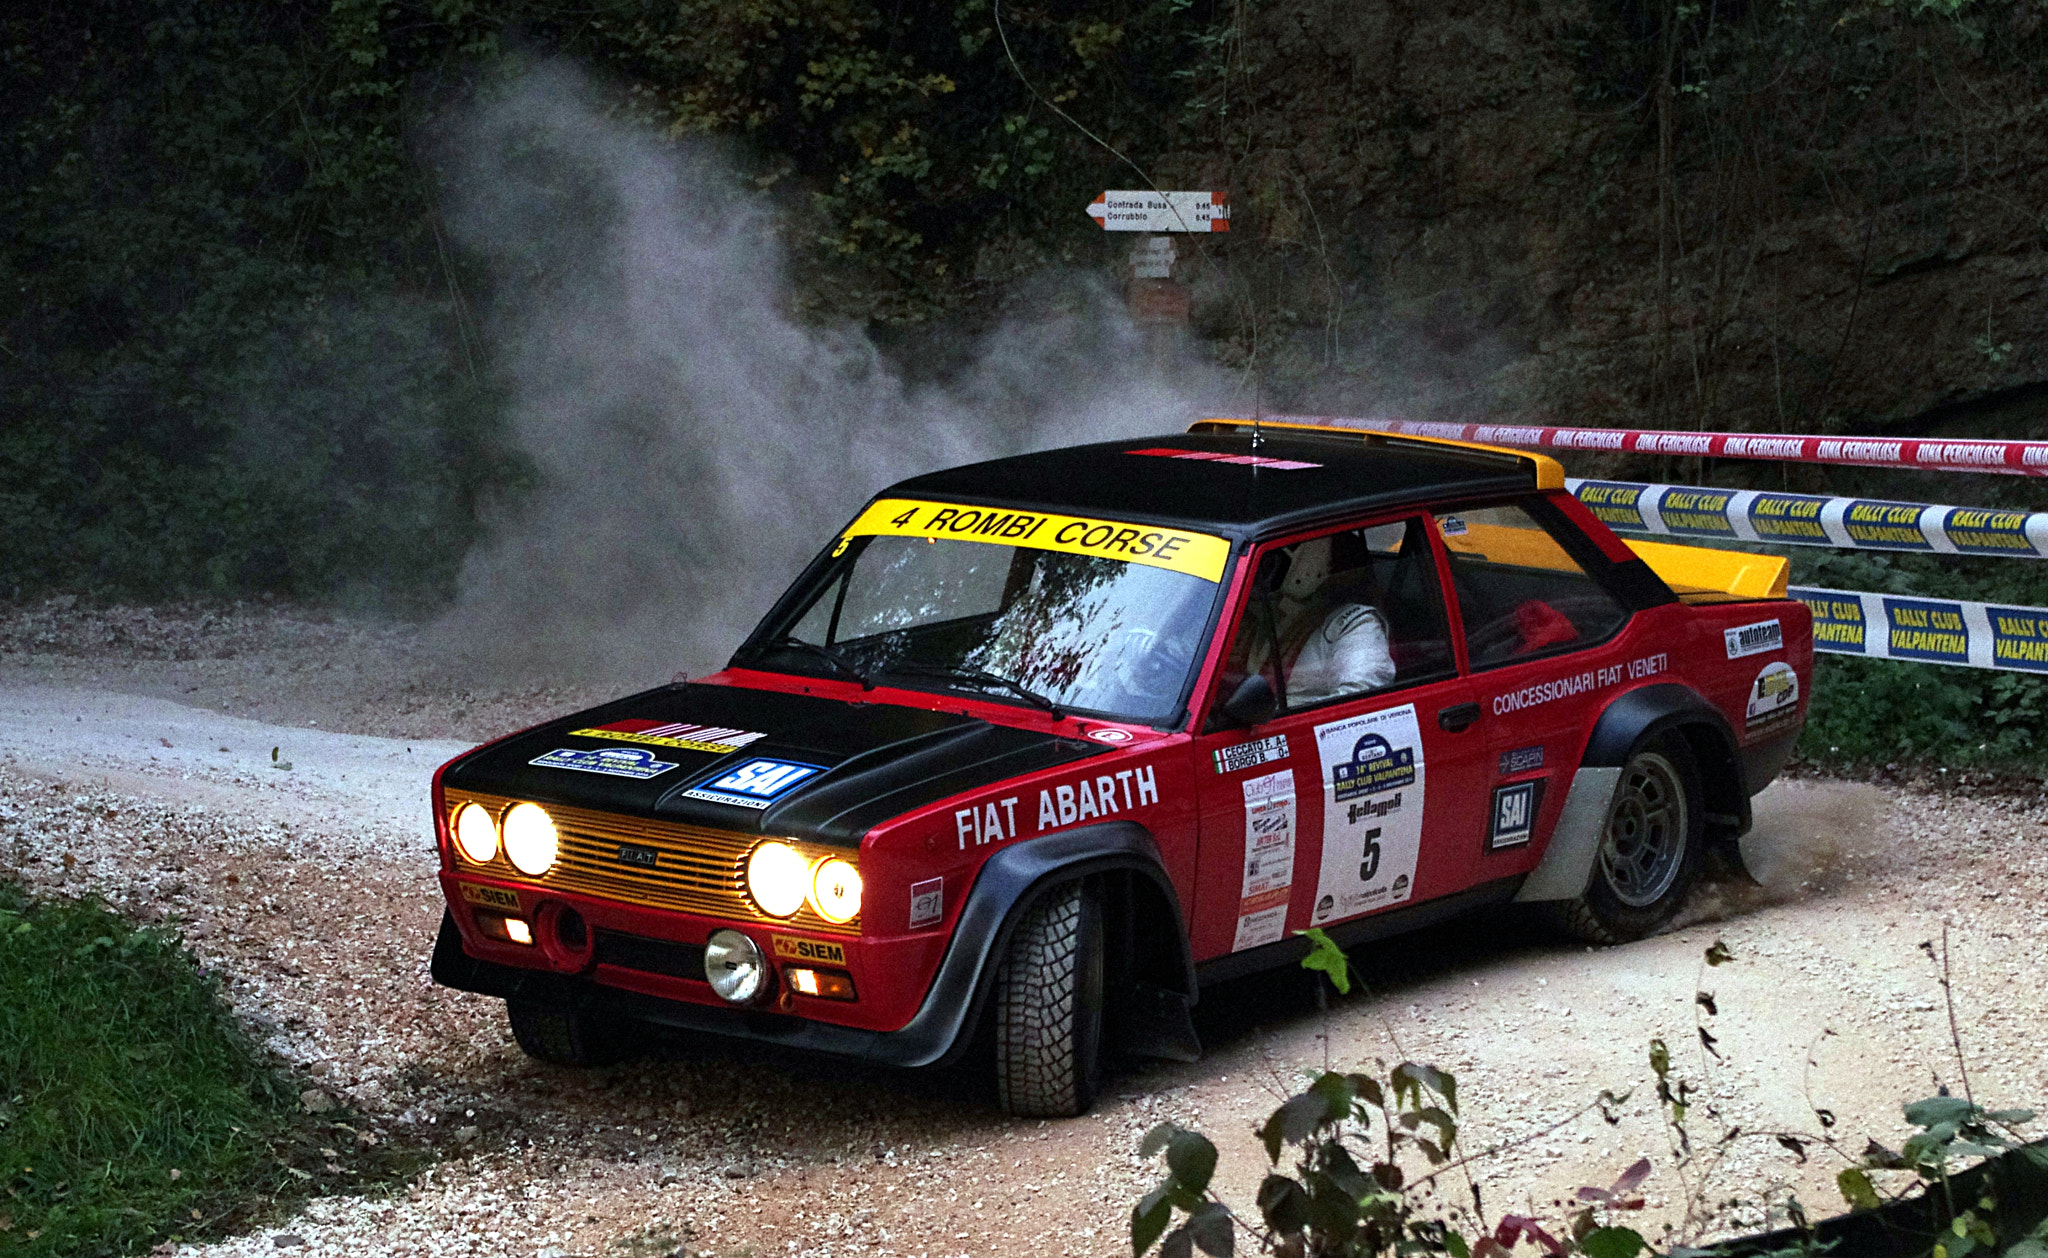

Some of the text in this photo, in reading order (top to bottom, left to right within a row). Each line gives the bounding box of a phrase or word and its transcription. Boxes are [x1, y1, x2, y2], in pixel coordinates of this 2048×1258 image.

[1107, 200, 1143, 209] Contrada
[1147, 201, 1167, 209] Busa
[1634, 433, 1659, 451] ZONA
[1658, 435, 1713, 454] PERICOLOSA
[1723, 437, 1750, 456] ZONA
[1748, 438, 1805, 458] PERICOLOSA
[1816, 440, 1843, 459] ZONA
[1843, 441, 1902, 461] PERICOLOSA
[1916, 443, 1944, 463] ZONA
[1943, 445, 2007, 465] PERICOLOSA
[1579, 486, 1640, 505] RALLY CLUB
[1664, 491, 1728, 512] RALLY CLUB
[1754, 498, 1822, 518] RALLY CLUB
[1850, 504, 1921, 524] RALLY CLUB
[1950, 510, 2027, 530] RALLY CLUB
[890, 507, 1191, 561] 4 ROMBI CORSE
[1846, 523, 1927, 544] VALPANTENA
[832, 536, 854, 558] 5
[1831, 602, 1861, 621] CLUB
[1893, 607, 1962, 631] RALLY CLUB
[1738, 623, 1781, 646] autoteam
[1812, 622, 1863, 645] PANTENA
[1997, 616, 2036, 637] RALLY
[1891, 630, 1967, 655] VALPANTENA
[1492, 653, 1668, 716] CONCESSIONARI FIAT VENETI
[1225, 741, 1264, 759] CECCATO
[1510, 752, 1544, 768] SCAPIN
[1228, 754, 1258, 771] BORGO
[714, 761, 812, 796] SAI
[1336, 779, 1355, 791] RALLY
[1356, 775, 1373, 787] CLUB
[685, 790, 767, 809] ASSICURAZIONI
[955, 765, 1160, 851] FIAT ABARTH
[1500, 790, 1528, 830] SAI
[621, 850, 653, 863] FIAT
[1359, 827, 1382, 882] 5
[480, 888, 519, 909] SIEM
[797, 941, 843, 962] SIEM
